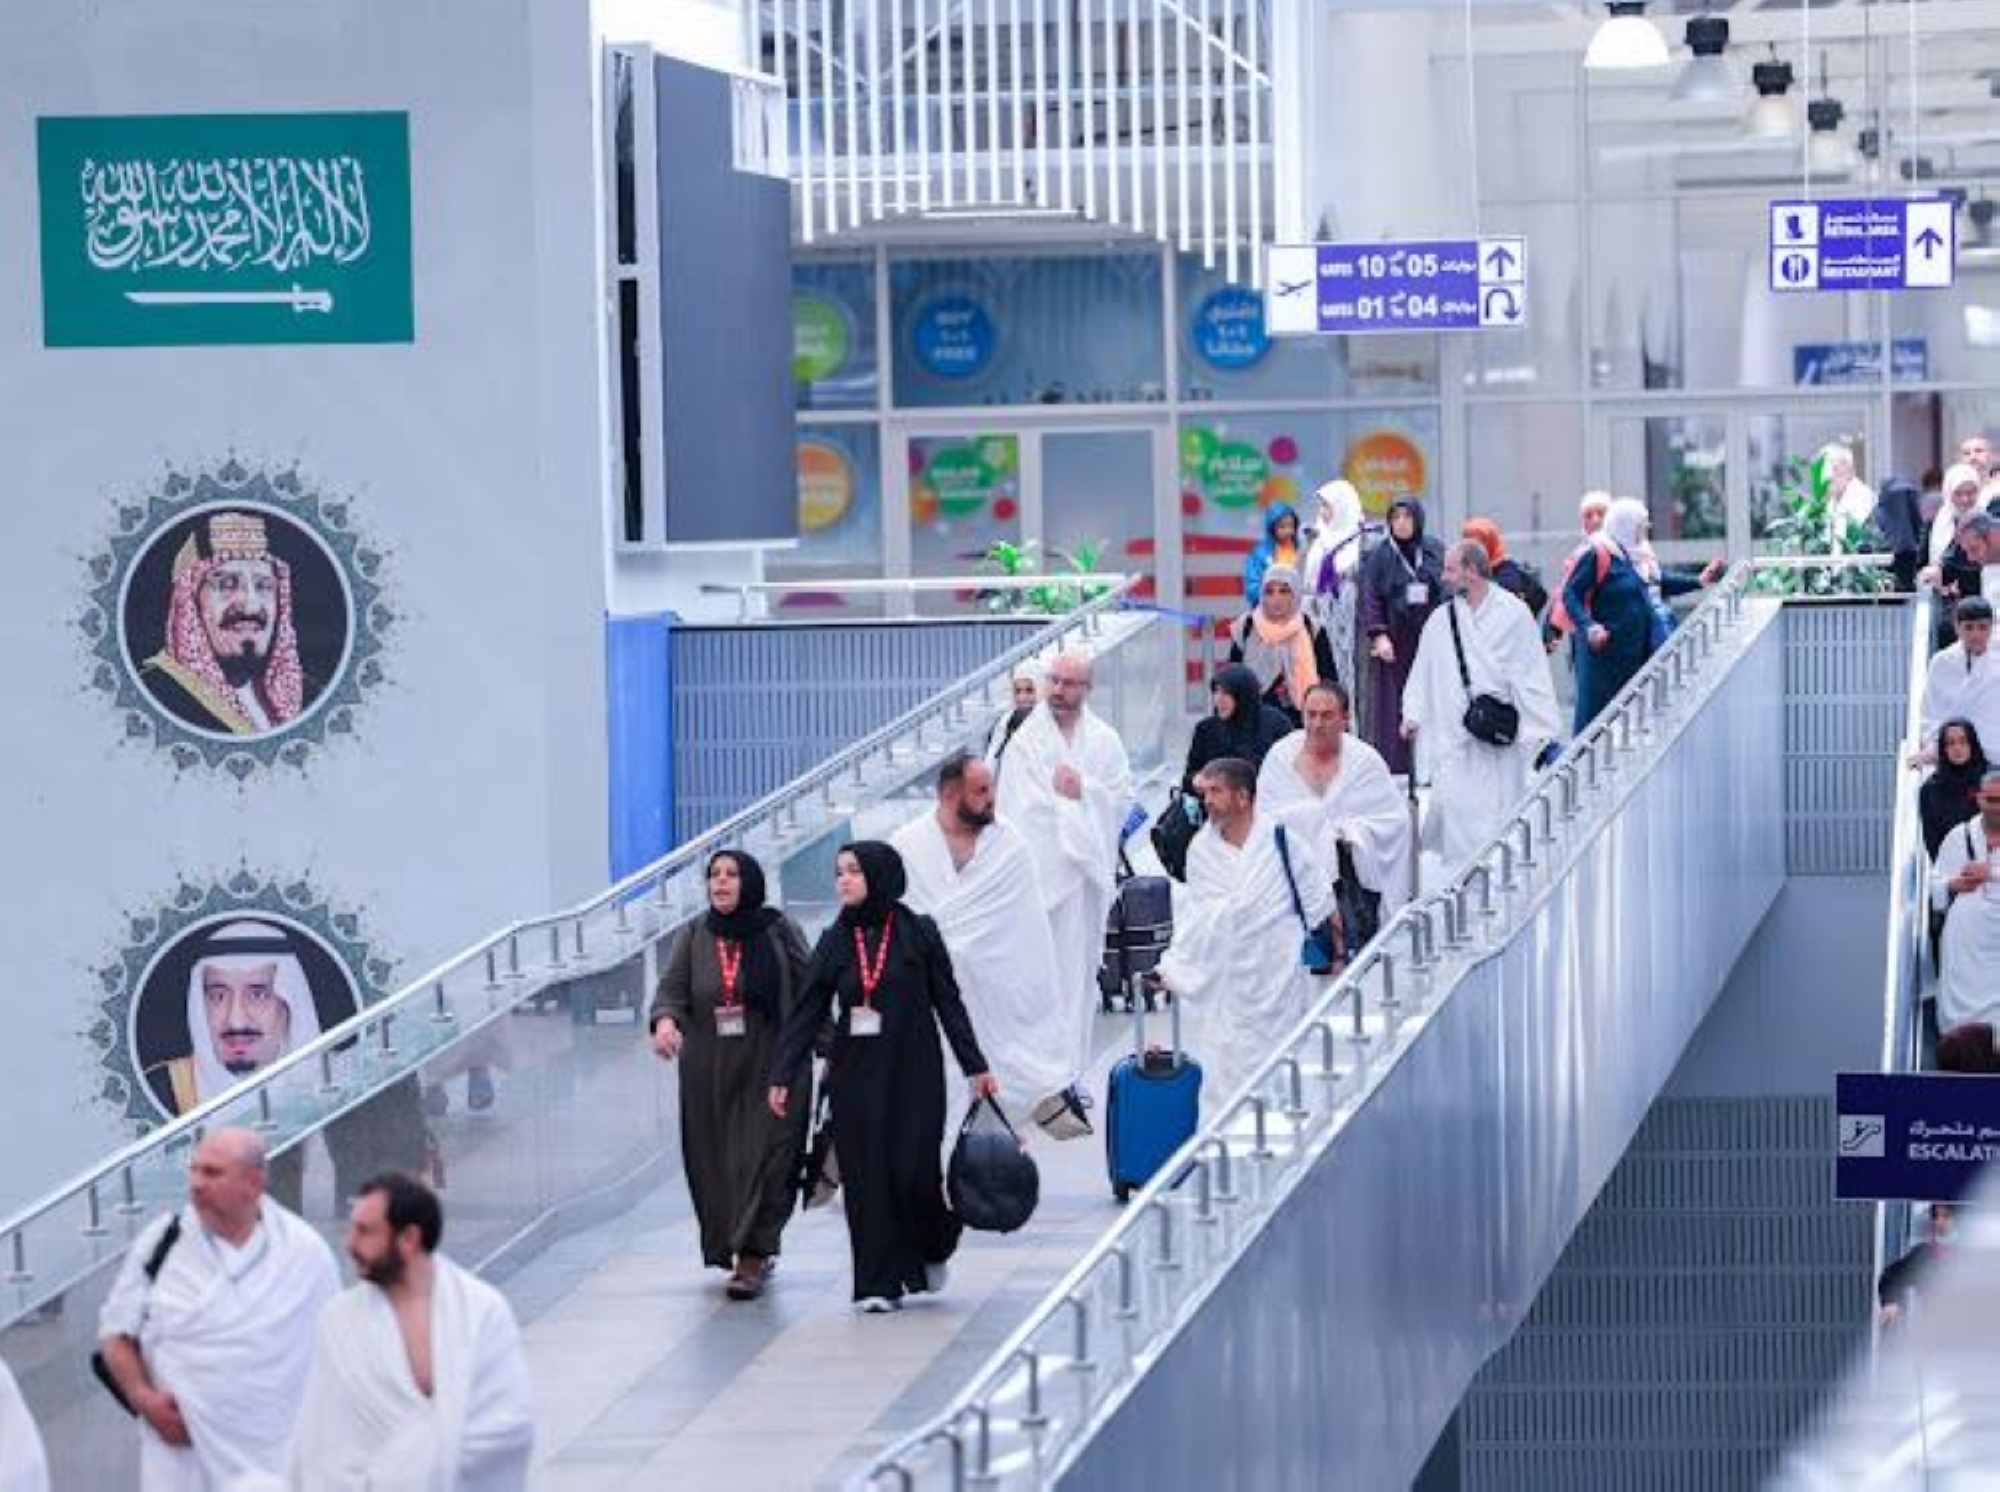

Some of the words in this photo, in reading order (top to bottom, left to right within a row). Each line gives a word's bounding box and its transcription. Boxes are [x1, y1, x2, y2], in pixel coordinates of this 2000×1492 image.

[1358, 253, 1385, 278] 10
[1408, 253, 1439, 278] 05
[1358, 295, 1385, 319] 01
[1408, 294, 1439, 319] 04
[1908, 1142, 2000, 1161] ESCALAT
